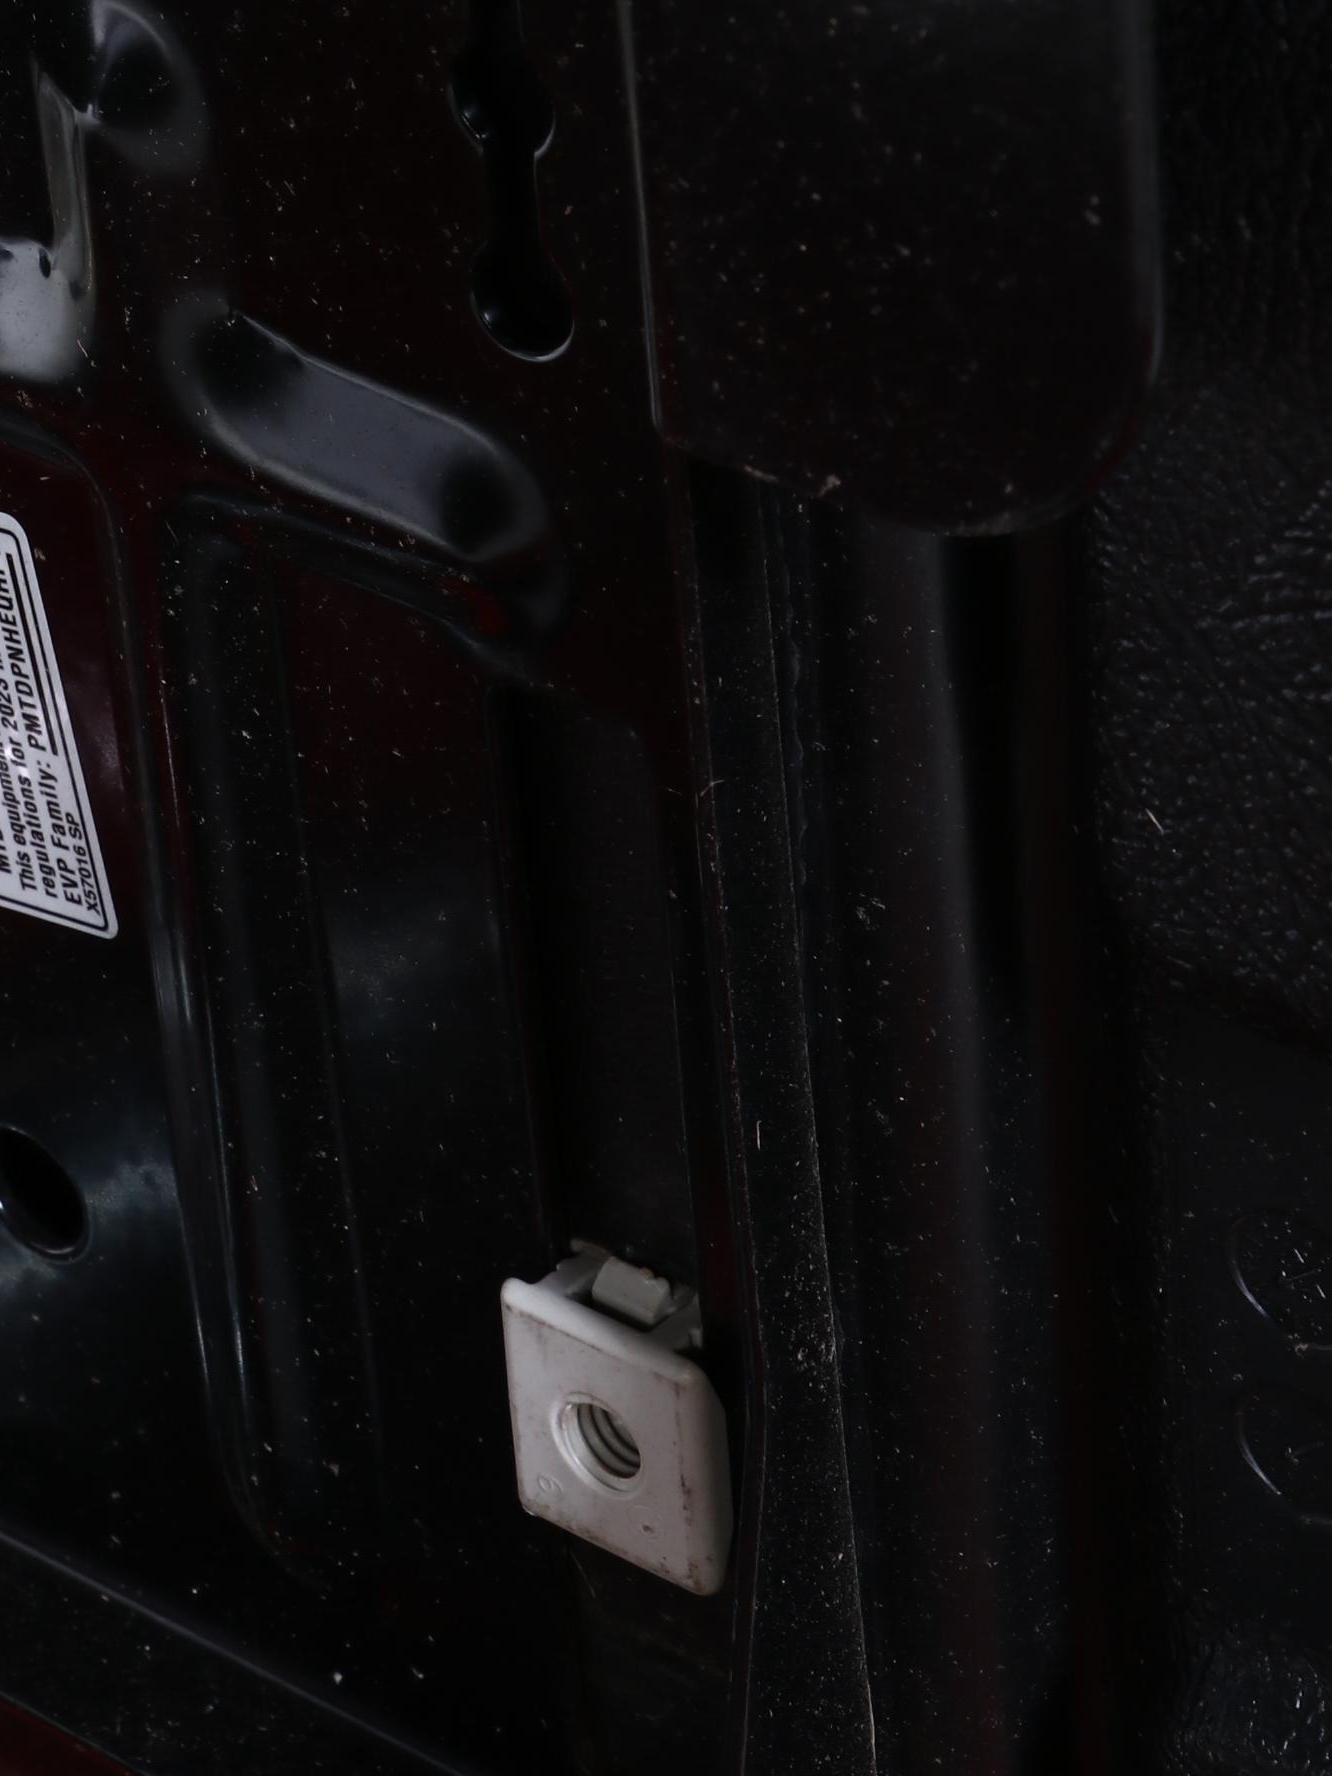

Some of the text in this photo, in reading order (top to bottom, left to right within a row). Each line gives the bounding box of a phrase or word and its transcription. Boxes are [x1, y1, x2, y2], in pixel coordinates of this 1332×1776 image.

[8, 736, 27, 767] for
[18, 775, 58, 898] regulations
[37, 761, 70, 851] Family:
[16, 851, 37, 890] This
[57, 858, 82, 905] EVP
[65, 812, 100, 915] X57016 SP
